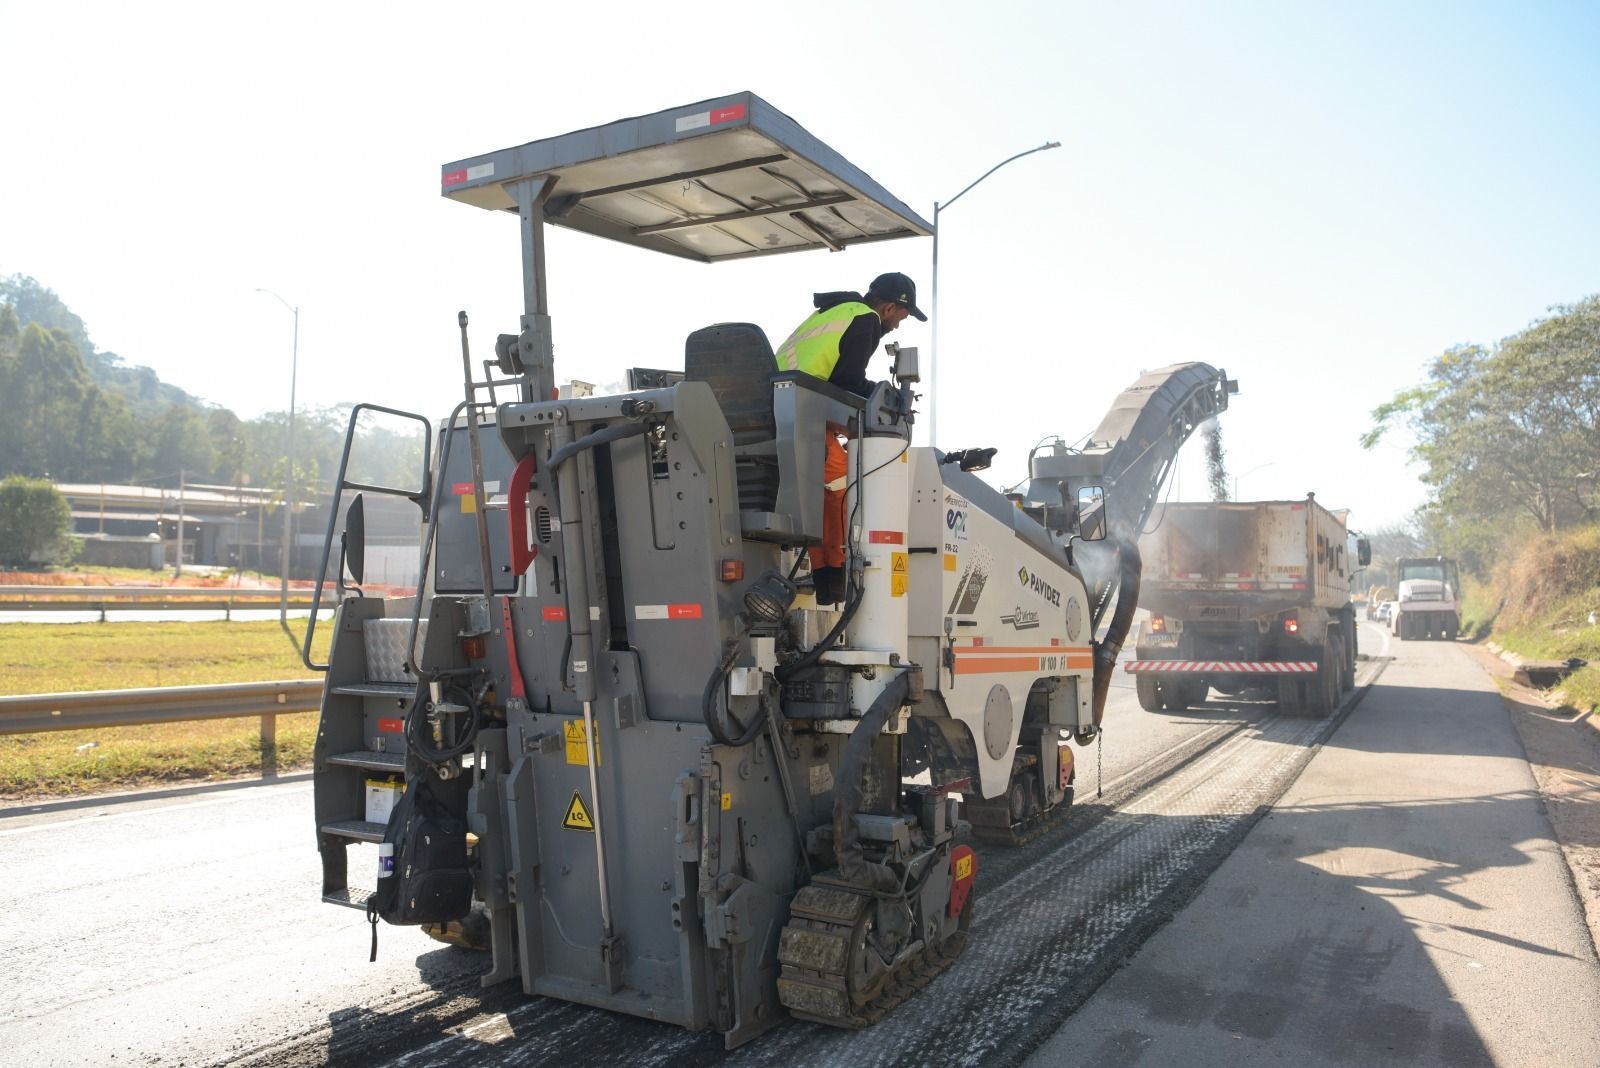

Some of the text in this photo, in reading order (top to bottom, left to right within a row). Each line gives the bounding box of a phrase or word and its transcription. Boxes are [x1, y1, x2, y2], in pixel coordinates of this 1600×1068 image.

[1030, 572, 1061, 608] PAVIDEZ
[1040, 655, 1047, 671] W
[1047, 655, 1057, 671] 100
